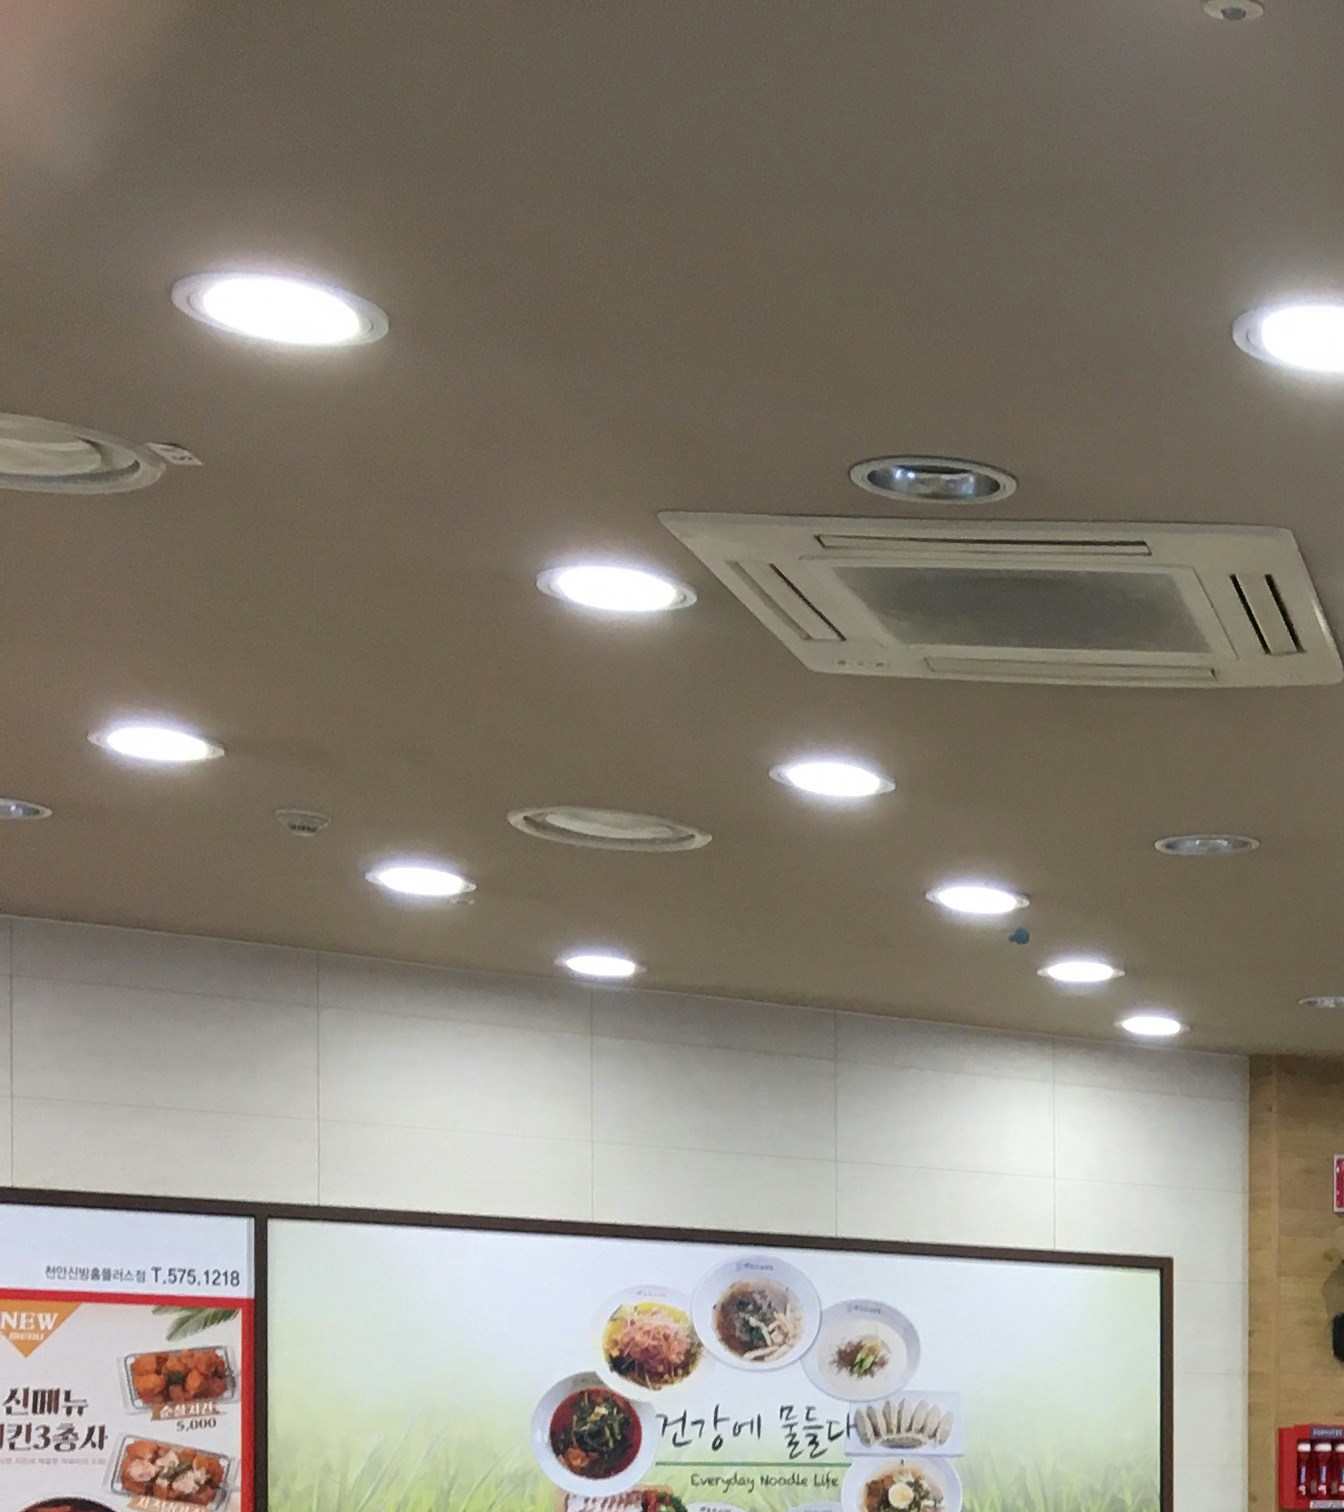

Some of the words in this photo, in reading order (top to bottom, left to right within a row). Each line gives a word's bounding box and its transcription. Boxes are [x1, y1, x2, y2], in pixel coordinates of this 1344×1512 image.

[151, 1266, 241, 1288] T.575.1218
[0, 1311, 59, 1331] NEW
[4, 1386, 89, 1417] 신메뉴
[176, 1418, 217, 1432] 5,000
[656, 1404, 762, 1452] 건강에
[778, 1404, 857, 1458] 물들다
[690, 1474, 755, 1494] Everyday
[759, 1473, 808, 1489] Noodle
[812, 1472, 839, 1489] Life
